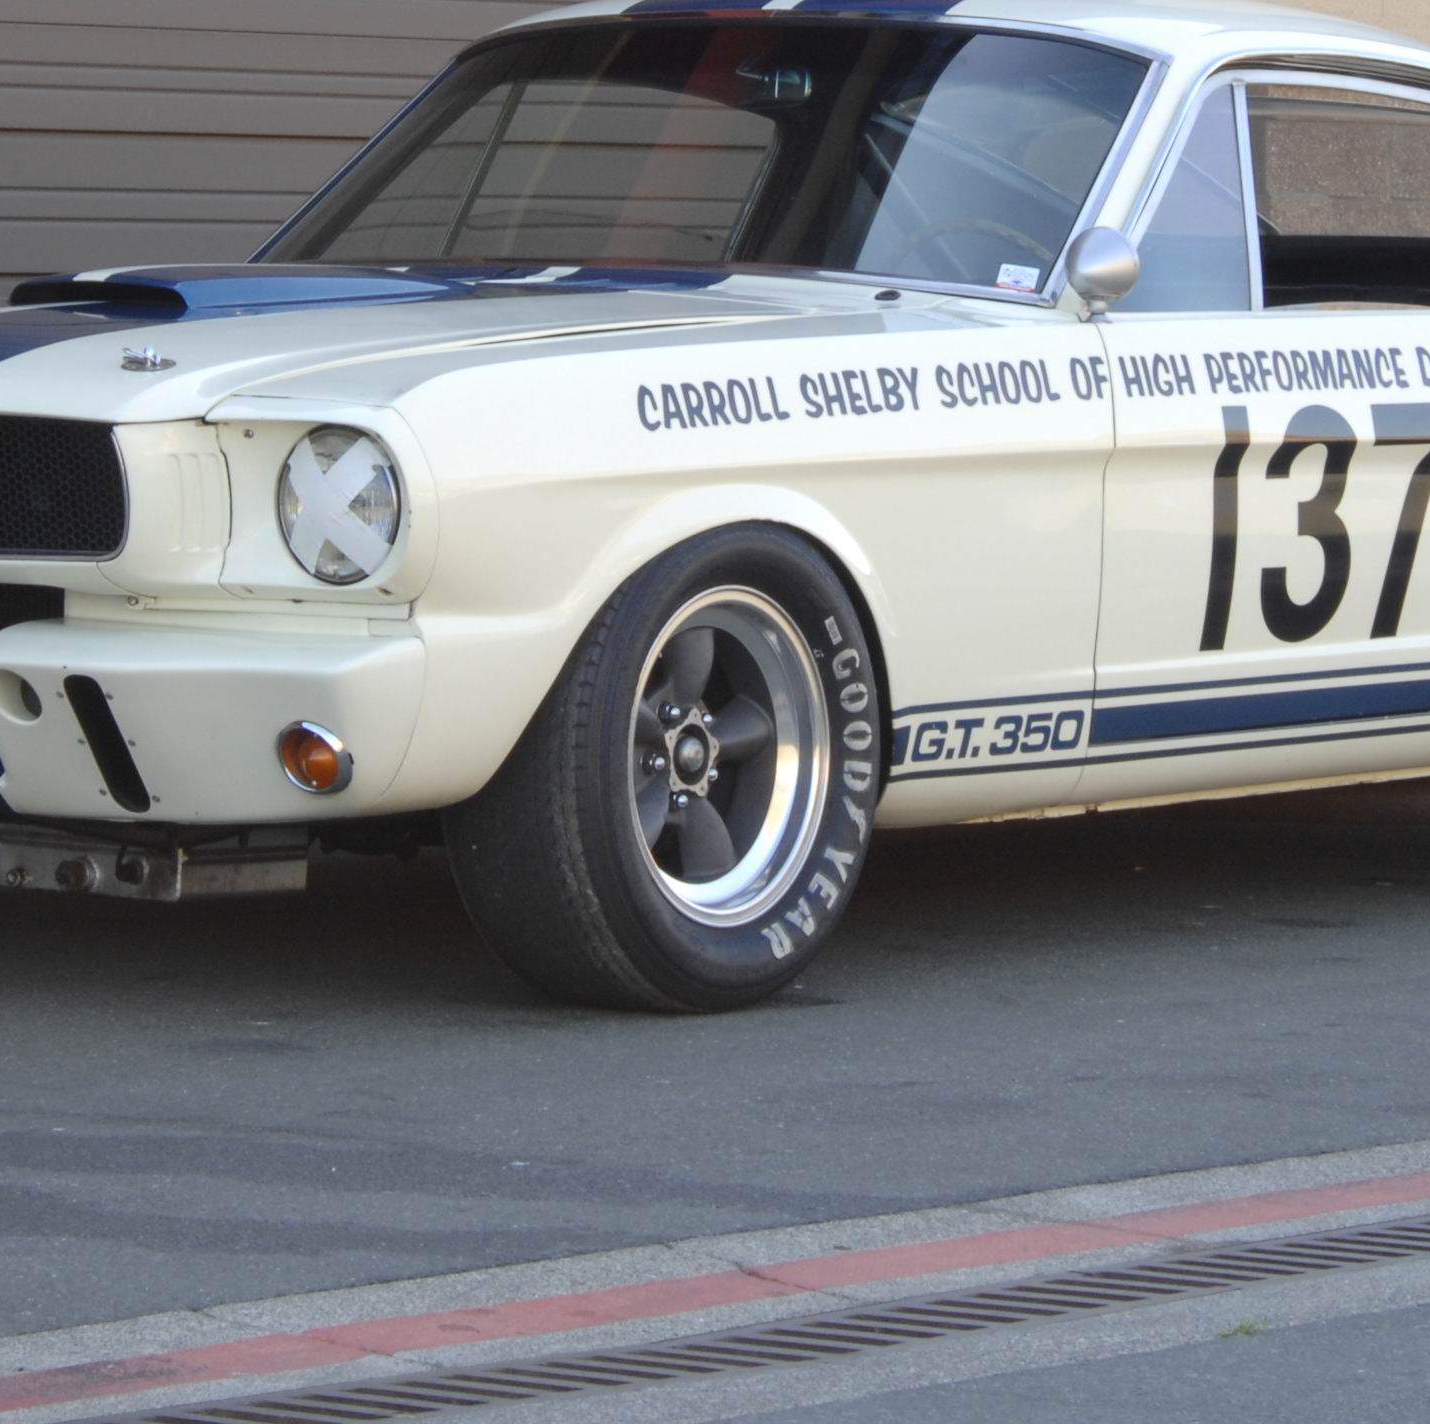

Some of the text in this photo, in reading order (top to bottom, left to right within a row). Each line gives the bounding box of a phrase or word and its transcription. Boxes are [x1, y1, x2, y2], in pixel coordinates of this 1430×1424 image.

[637, 376, 790, 431] CARROLL
[800, 367, 919, 418] SHELBY
[935, 359, 1060, 408] SCHOOL
[1070, 356, 1108, 400] OF
[1118, 353, 1196, 397] HIGH
[1203, 347, 1410, 394] PERFORMANCE
